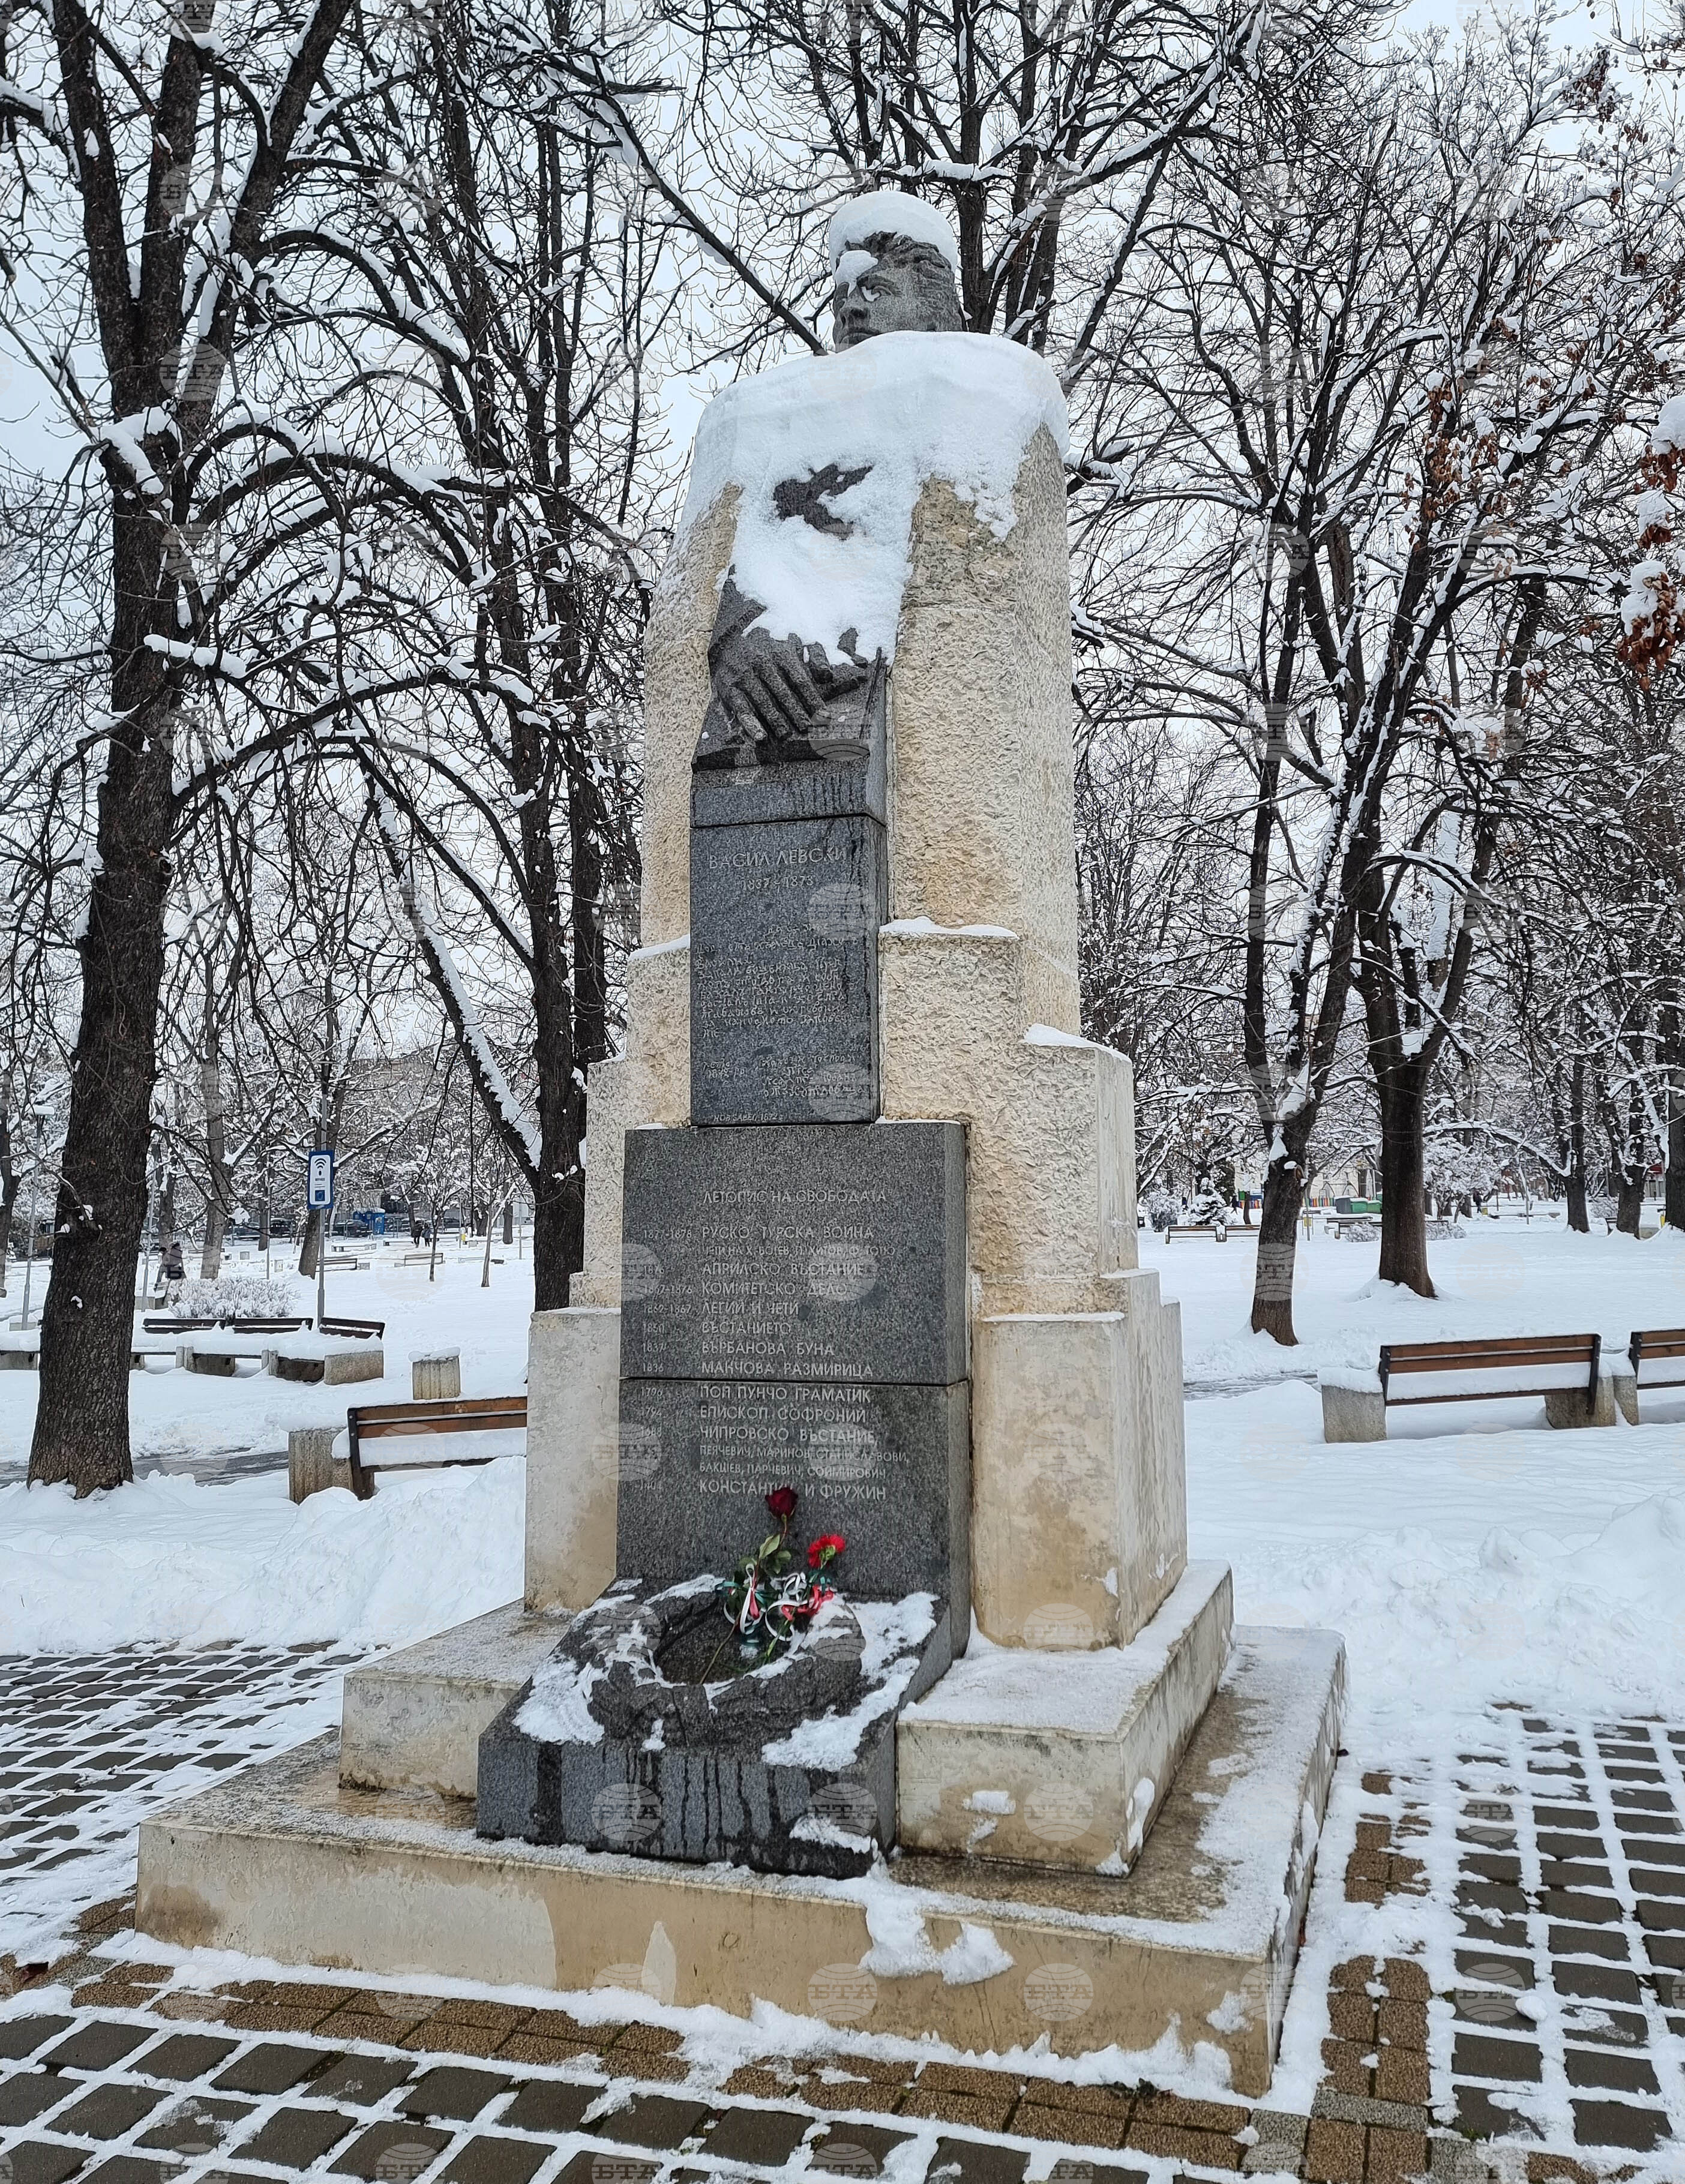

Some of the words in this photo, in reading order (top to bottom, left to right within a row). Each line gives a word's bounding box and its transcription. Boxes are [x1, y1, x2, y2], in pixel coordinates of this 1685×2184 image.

[709, 851, 770, 869] ВАСИЛ
[776, 845, 847, 865] ЛЕВСКИ
[703, 1190, 767, 1204] ЛЕТОПИС
[772, 1190, 792, 1202] НА
[796, 1189, 886, 1204] СВОБОДАТА
[701, 1262, 780, 1276] АПРИЛСКО
[790, 1262, 864, 1276] ВЪСТАНИЕ
[701, 1282, 796, 1296] КОМИТЕТСКО
[807, 1283, 847, 1296] ДЕЛО
[766, 1301, 799, 1315] ЧЕТИ
[701, 1321, 791, 1334] ВЪСТАНИЕТО
[701, 1341, 786, 1354] ВЪРБАНОВА
[797, 1342, 835, 1355] БУНА
[643, 1363, 664, 1372] 1836
[783, 1361, 873, 1379] РАЗМИРИЦА
[641, 1387, 663, 1397] 1796
[700, 1385, 731, 1399] ПОП
[737, 1386, 787, 1400] ПУНЧО
[795, 1387, 871, 1403] ГРАМАТИК
[700, 1405, 768, 1420] ЕПИСКОП
[700, 1426, 789, 1441] ЧИПРОВСКО
[700, 1445, 754, 1458] ПЕЯЧЕВИЧ,
[805, 1483, 815, 1498] И
[820, 1483, 886, 1500] ФРУЖИН
